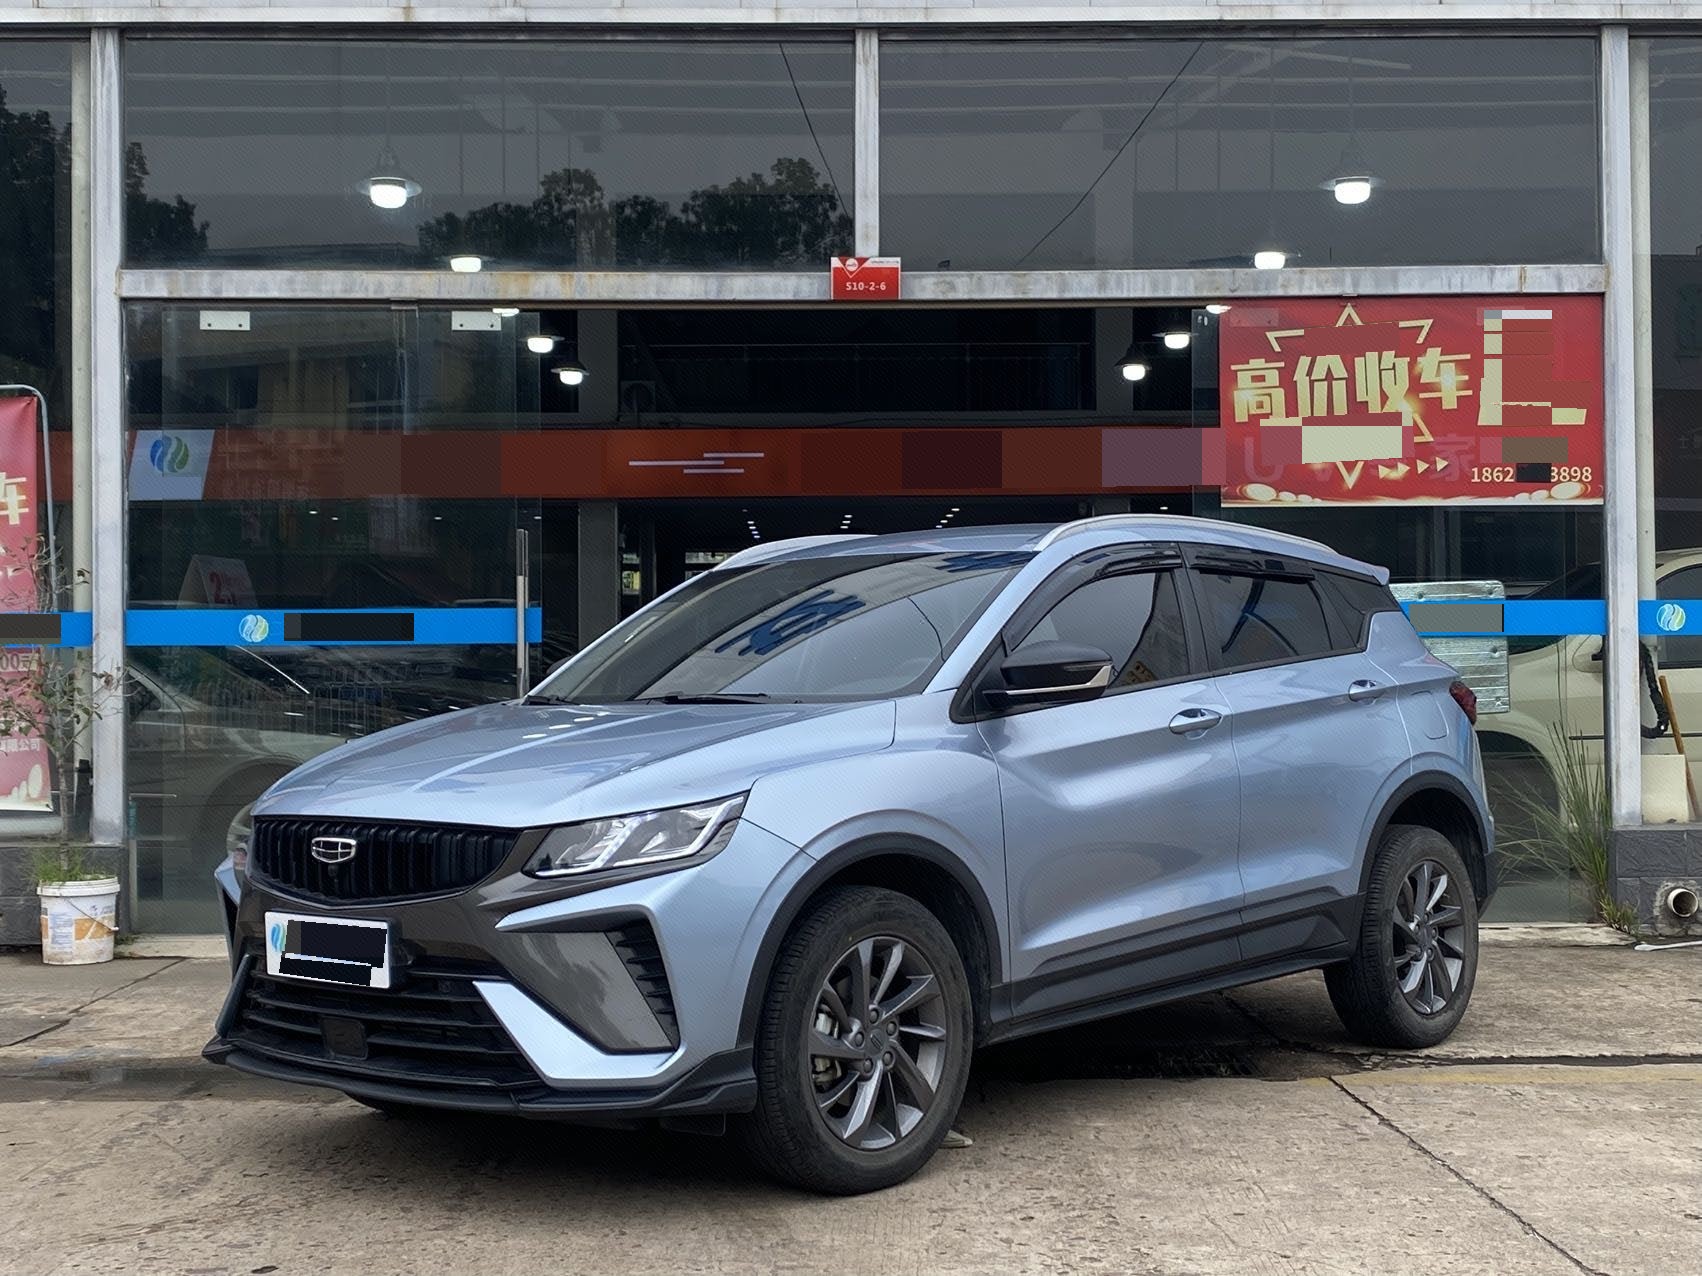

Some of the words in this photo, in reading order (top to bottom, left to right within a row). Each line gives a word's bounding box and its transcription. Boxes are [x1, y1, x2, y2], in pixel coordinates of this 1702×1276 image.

[1230, 347, 1474, 423] 高价收车
[1471, 466, 1593, 483] 18623898
